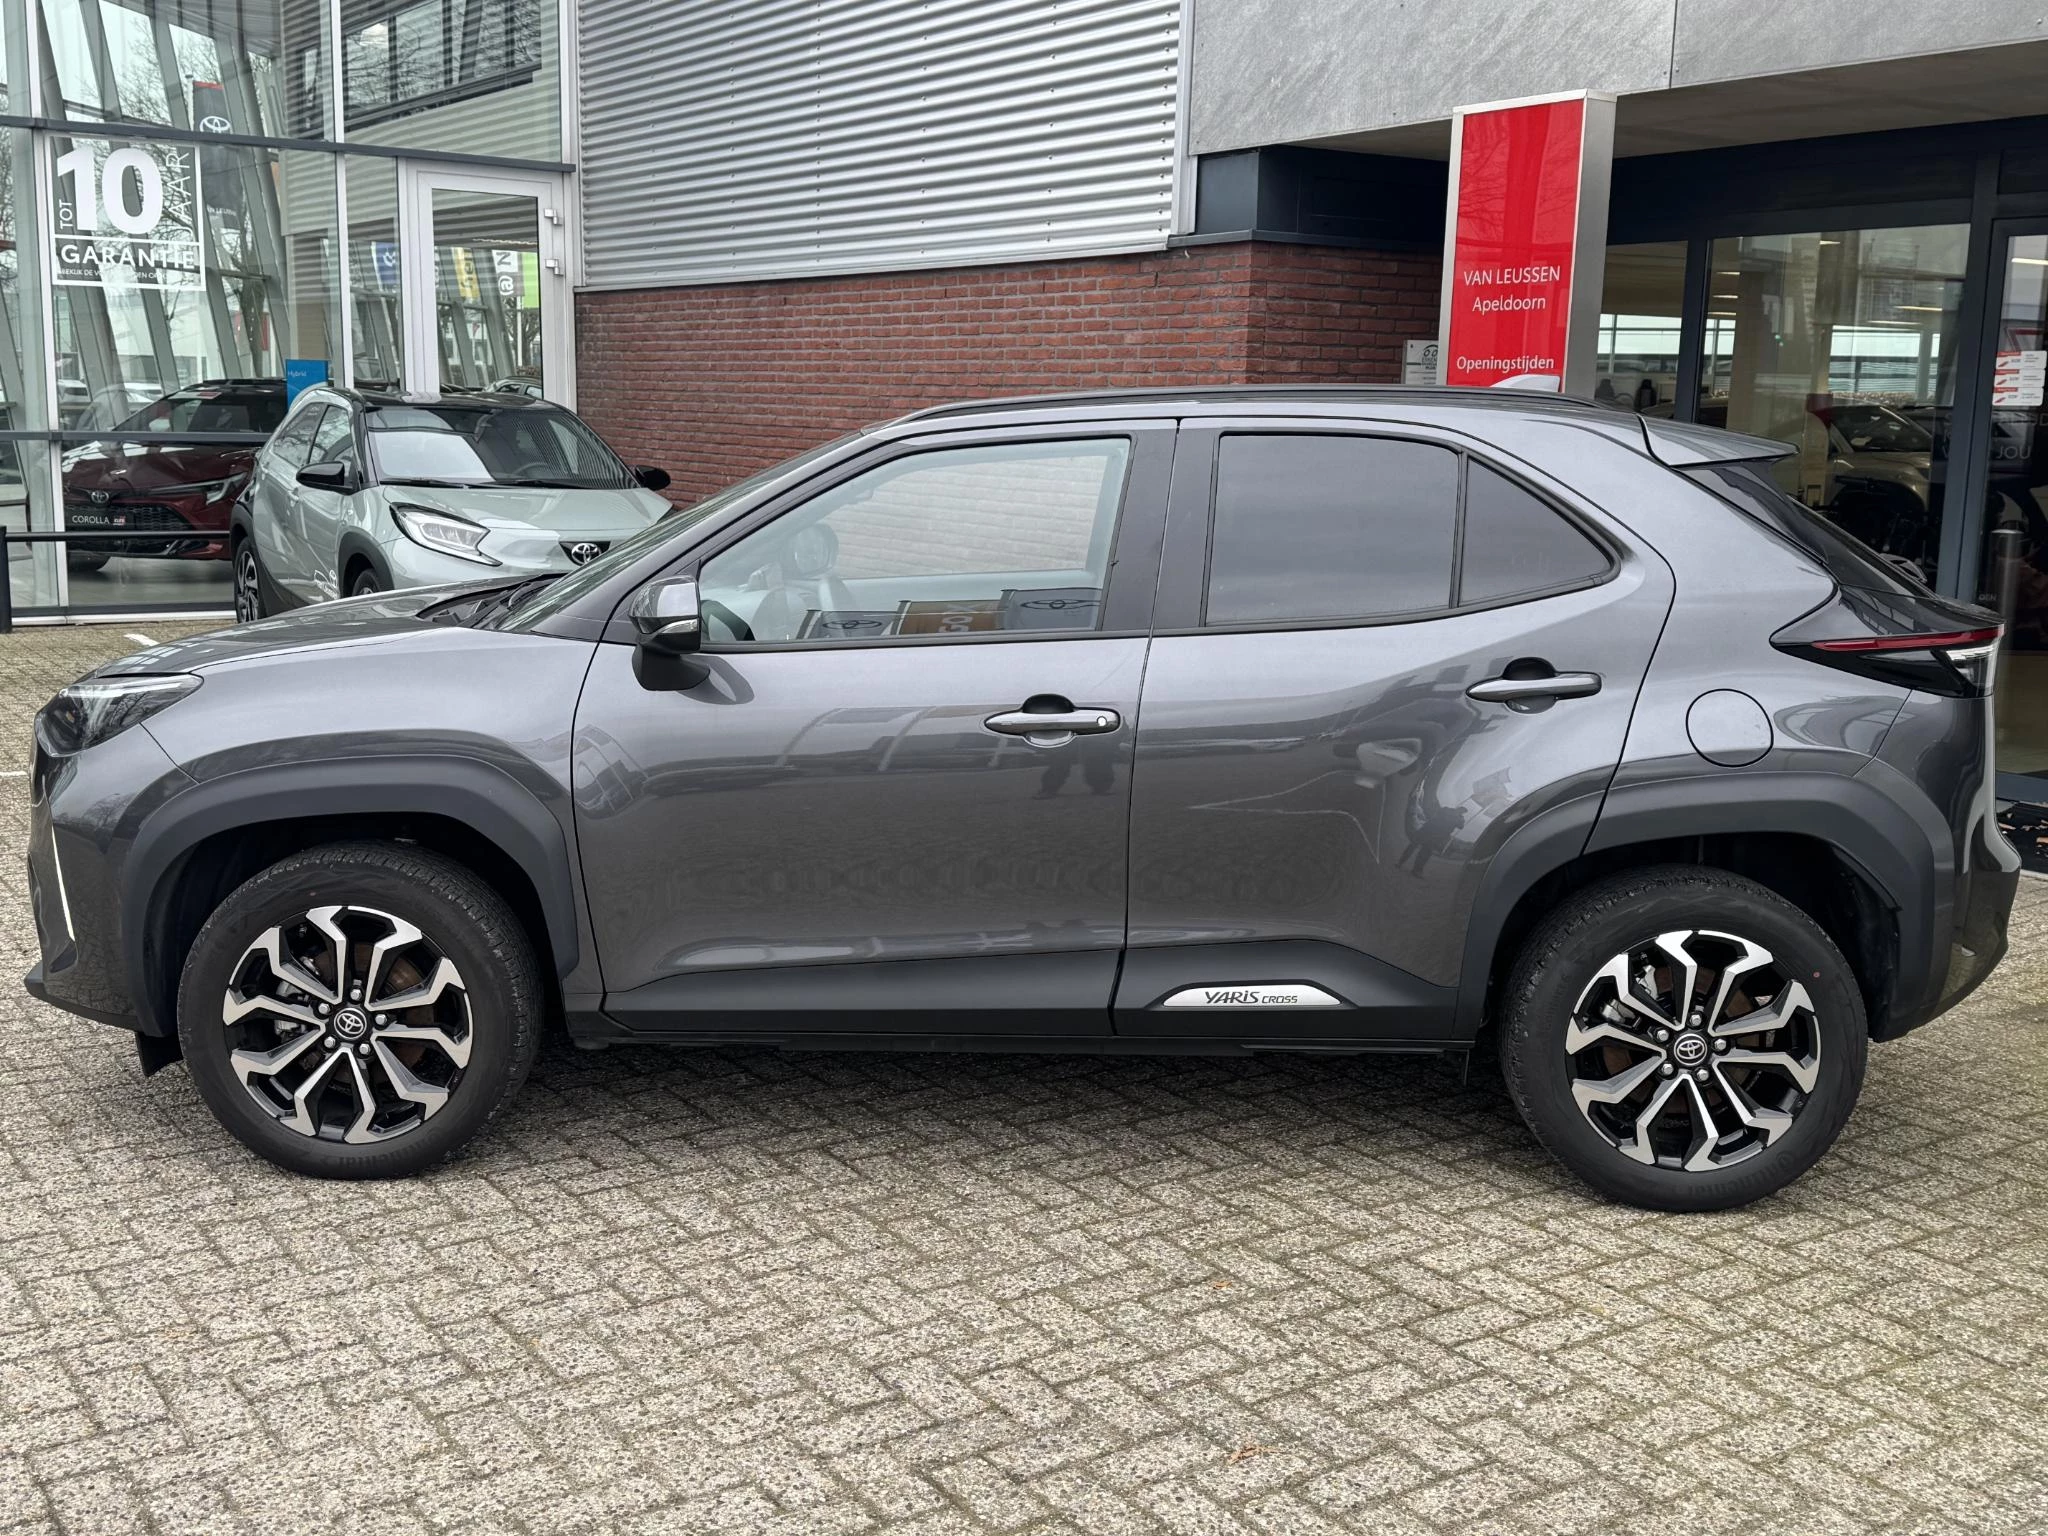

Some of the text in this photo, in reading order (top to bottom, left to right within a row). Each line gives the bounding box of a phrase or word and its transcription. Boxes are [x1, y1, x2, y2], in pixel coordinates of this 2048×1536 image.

[57, 148, 163, 234] 10
[166, 152, 193, 237] JAAR
[59, 199, 73, 229] TOT
[61, 244, 195, 270] GARANTIE
[1463, 265, 1560, 286] VAN LEUSSEN
[1472, 294, 1546, 316] Apeldoorn
[1456, 355, 1555, 373] Openingstijden
[71, 515, 110, 524] COROLLA
[1262, 995, 1298, 1004] CROSS
